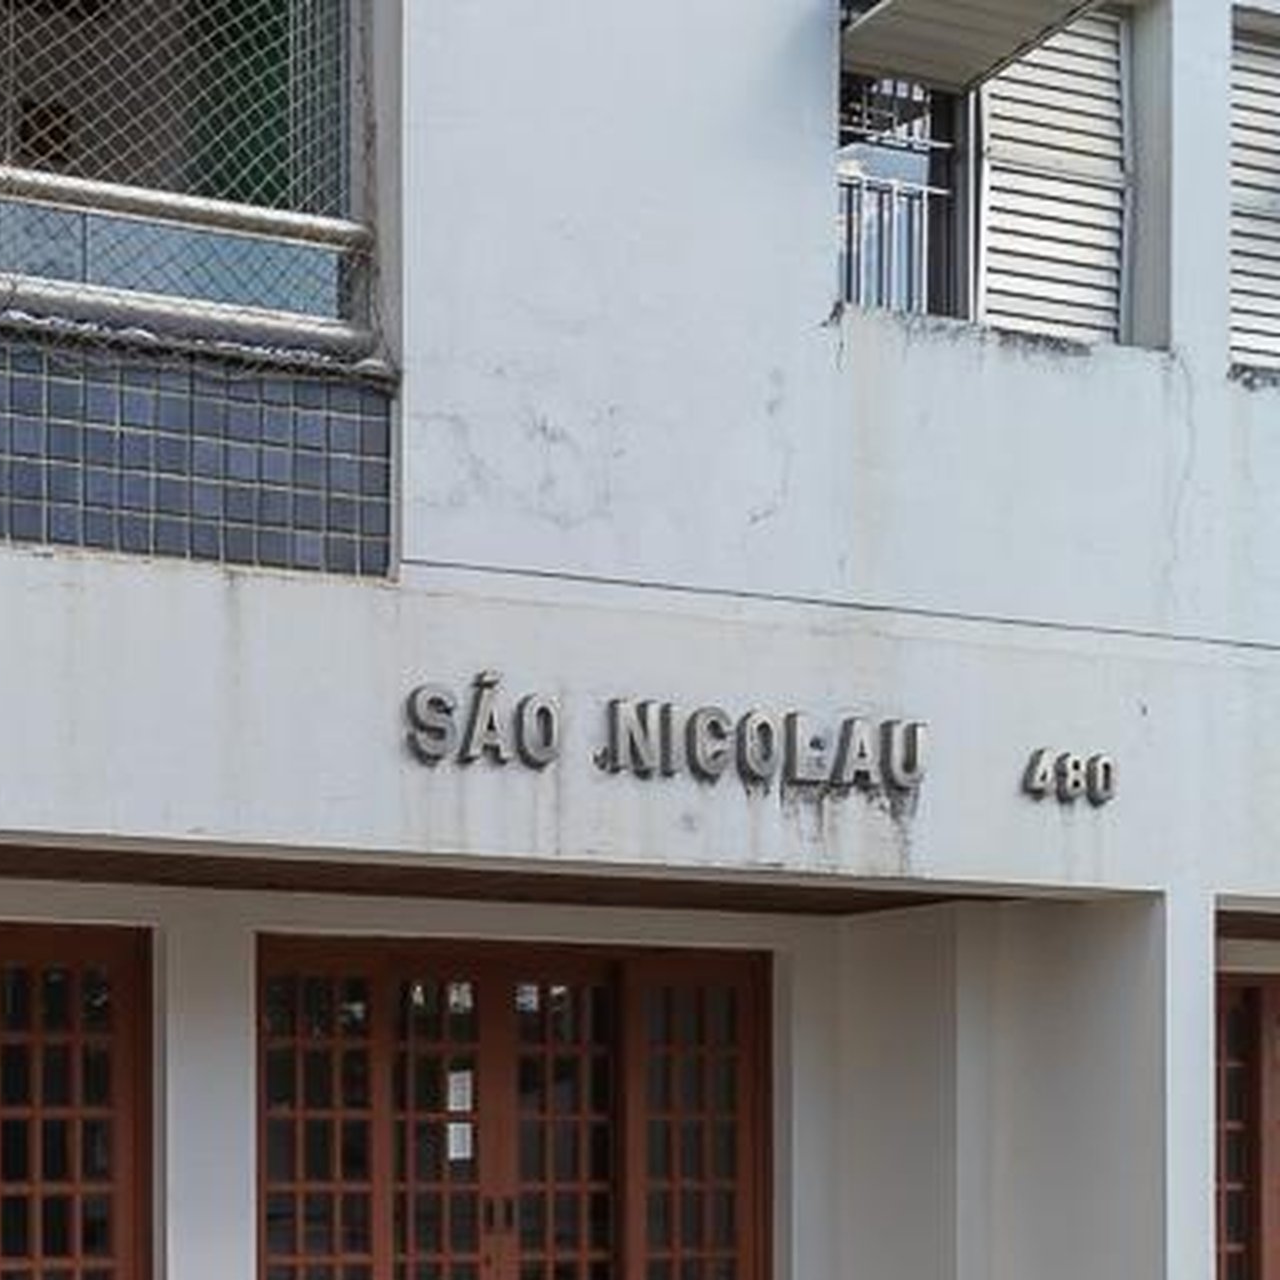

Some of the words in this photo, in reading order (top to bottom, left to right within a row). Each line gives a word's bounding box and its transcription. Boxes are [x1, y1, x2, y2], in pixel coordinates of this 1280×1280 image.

[406, 671, 560, 770] SÃO
[602, 698, 928, 793] NICOLAU
[1022, 748, 1118, 807] 480
